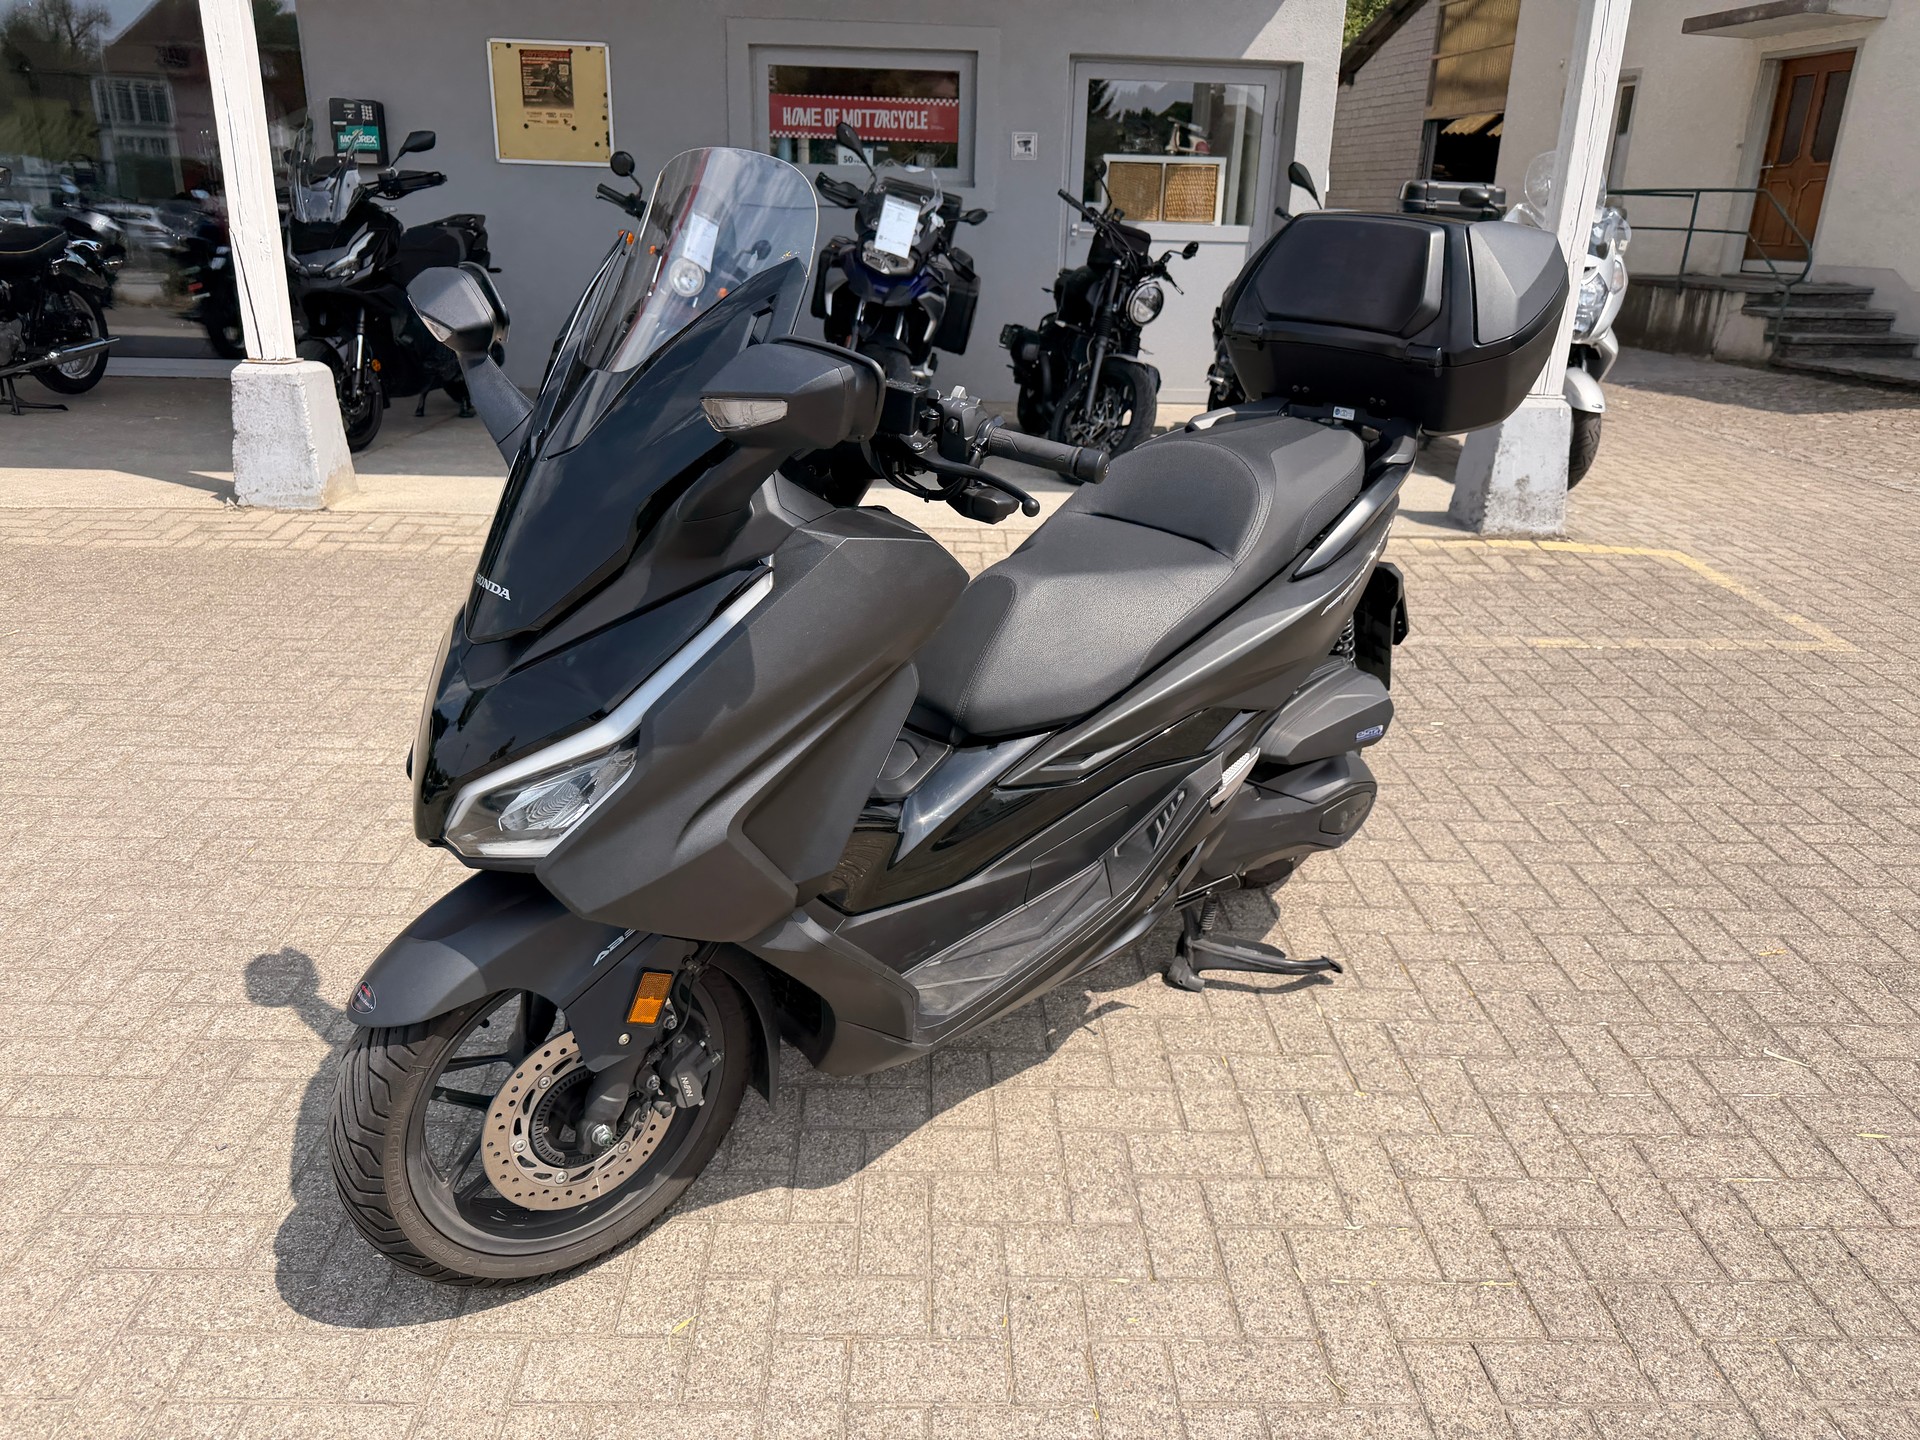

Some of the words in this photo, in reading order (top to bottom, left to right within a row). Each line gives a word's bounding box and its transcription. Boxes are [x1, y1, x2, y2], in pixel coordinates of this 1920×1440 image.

[783, 107, 821, 127] HOME
[824, 108, 840, 126] OF
[843, 155, 854, 164] 50
[401, 1208, 431, 1240] CITY
